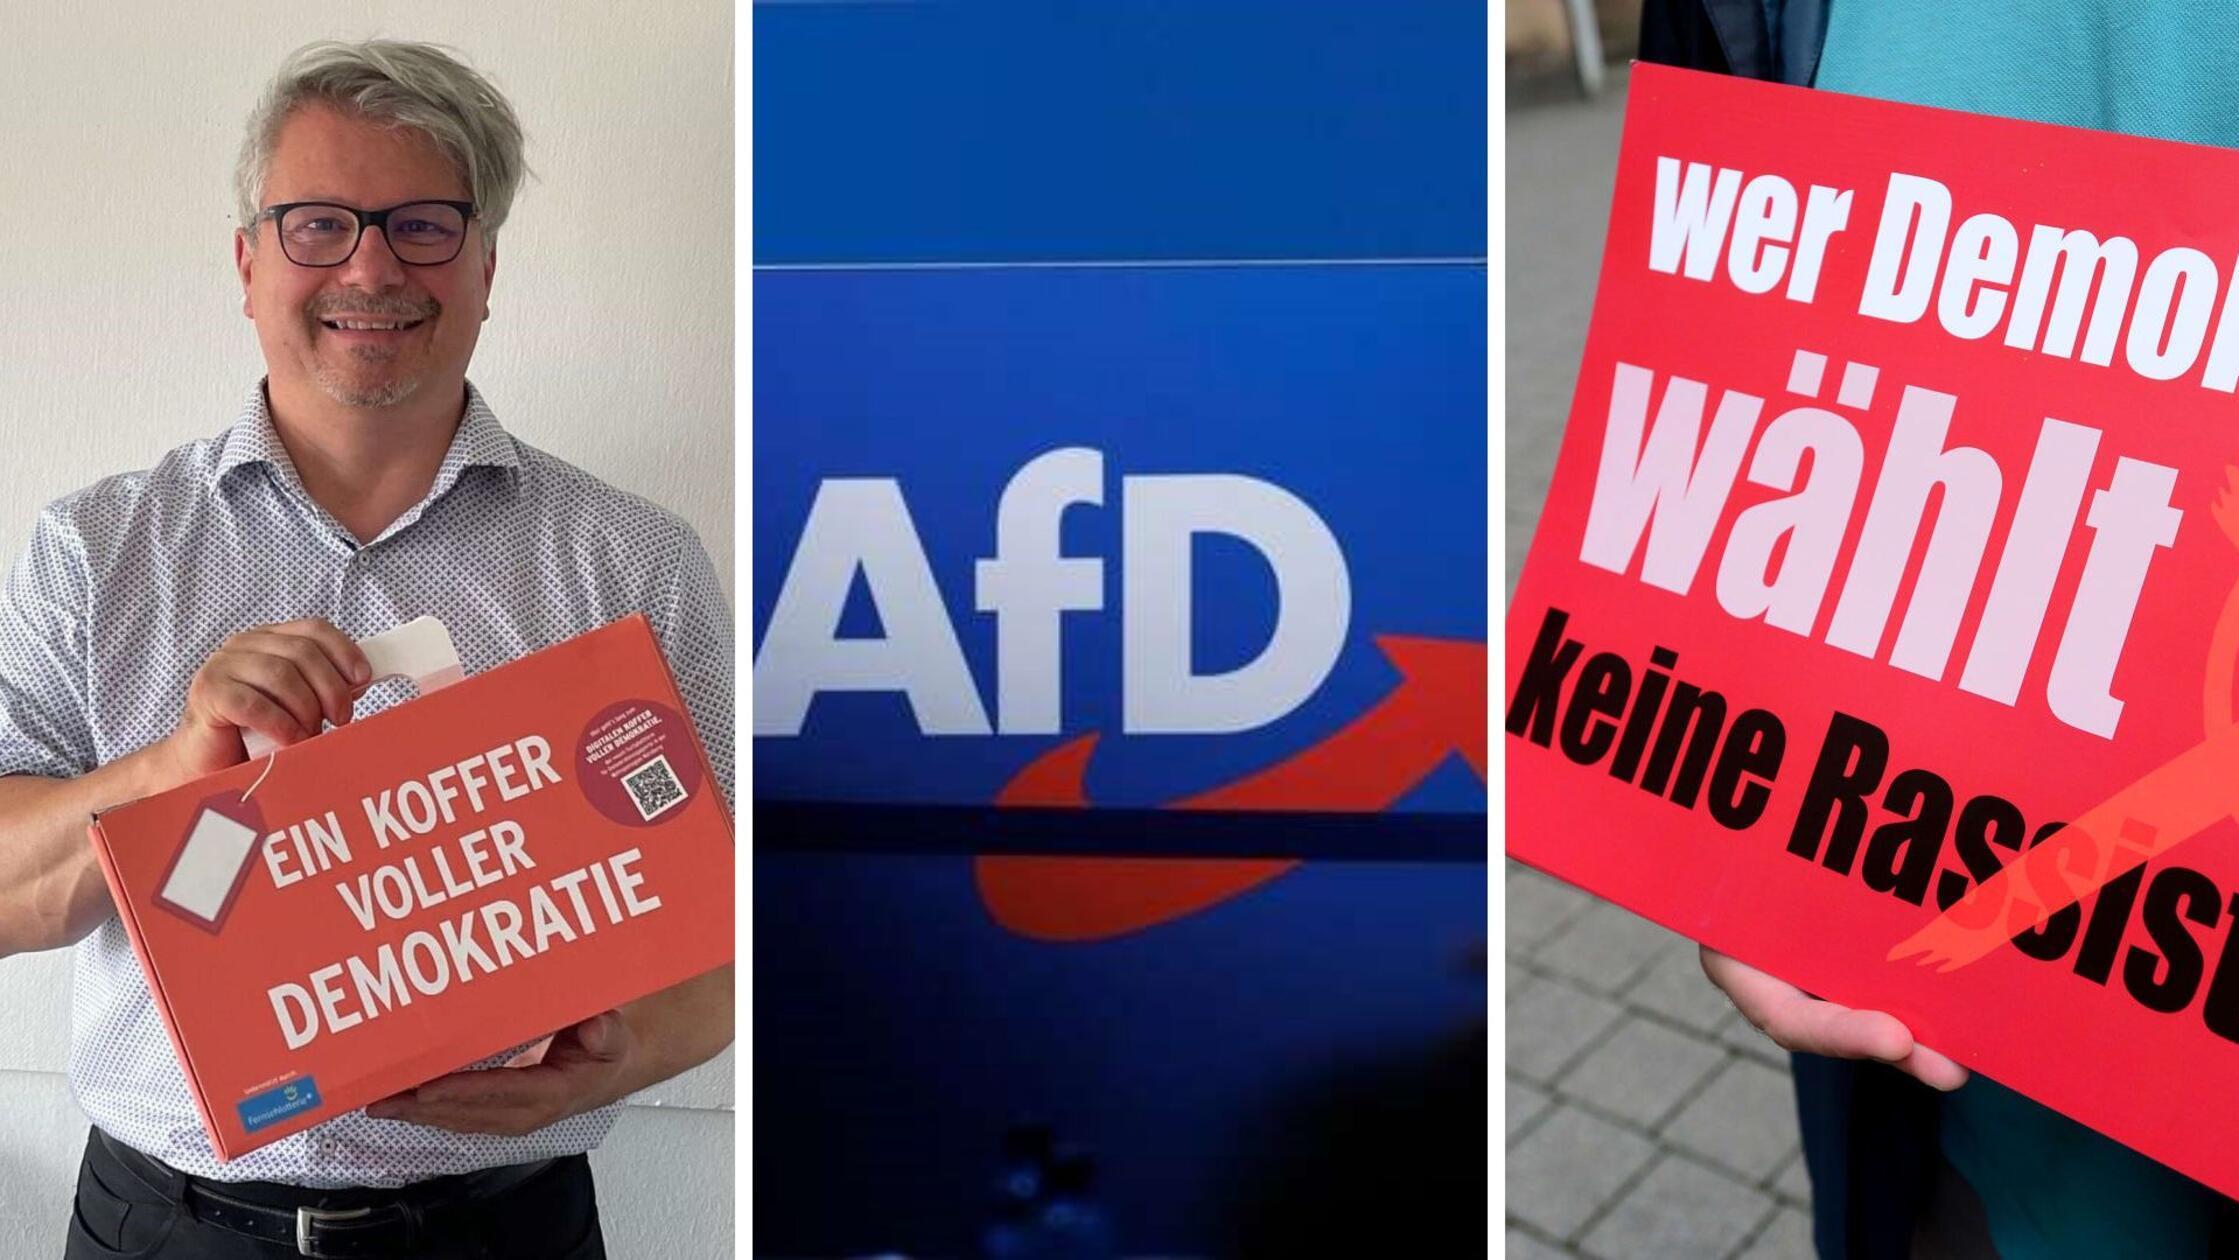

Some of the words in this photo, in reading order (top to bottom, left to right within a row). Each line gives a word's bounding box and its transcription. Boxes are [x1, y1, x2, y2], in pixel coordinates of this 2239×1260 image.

[1649, 156, 1854, 304] wer
[752, 447, 1351, 735] AfD
[1579, 349, 2184, 740] wählt
[585, 725, 624, 754] DIGITALEN
[622, 709, 653, 732] KOFFER
[585, 742, 615, 764] VOLLER
[1505, 606, 1786, 831] keine
[262, 811, 352, 889] EIN
[361, 735, 562, 849] KOFFER
[335, 820, 536, 931] VOLLER
[267, 847, 662, 1050] DEMOKRATIE
